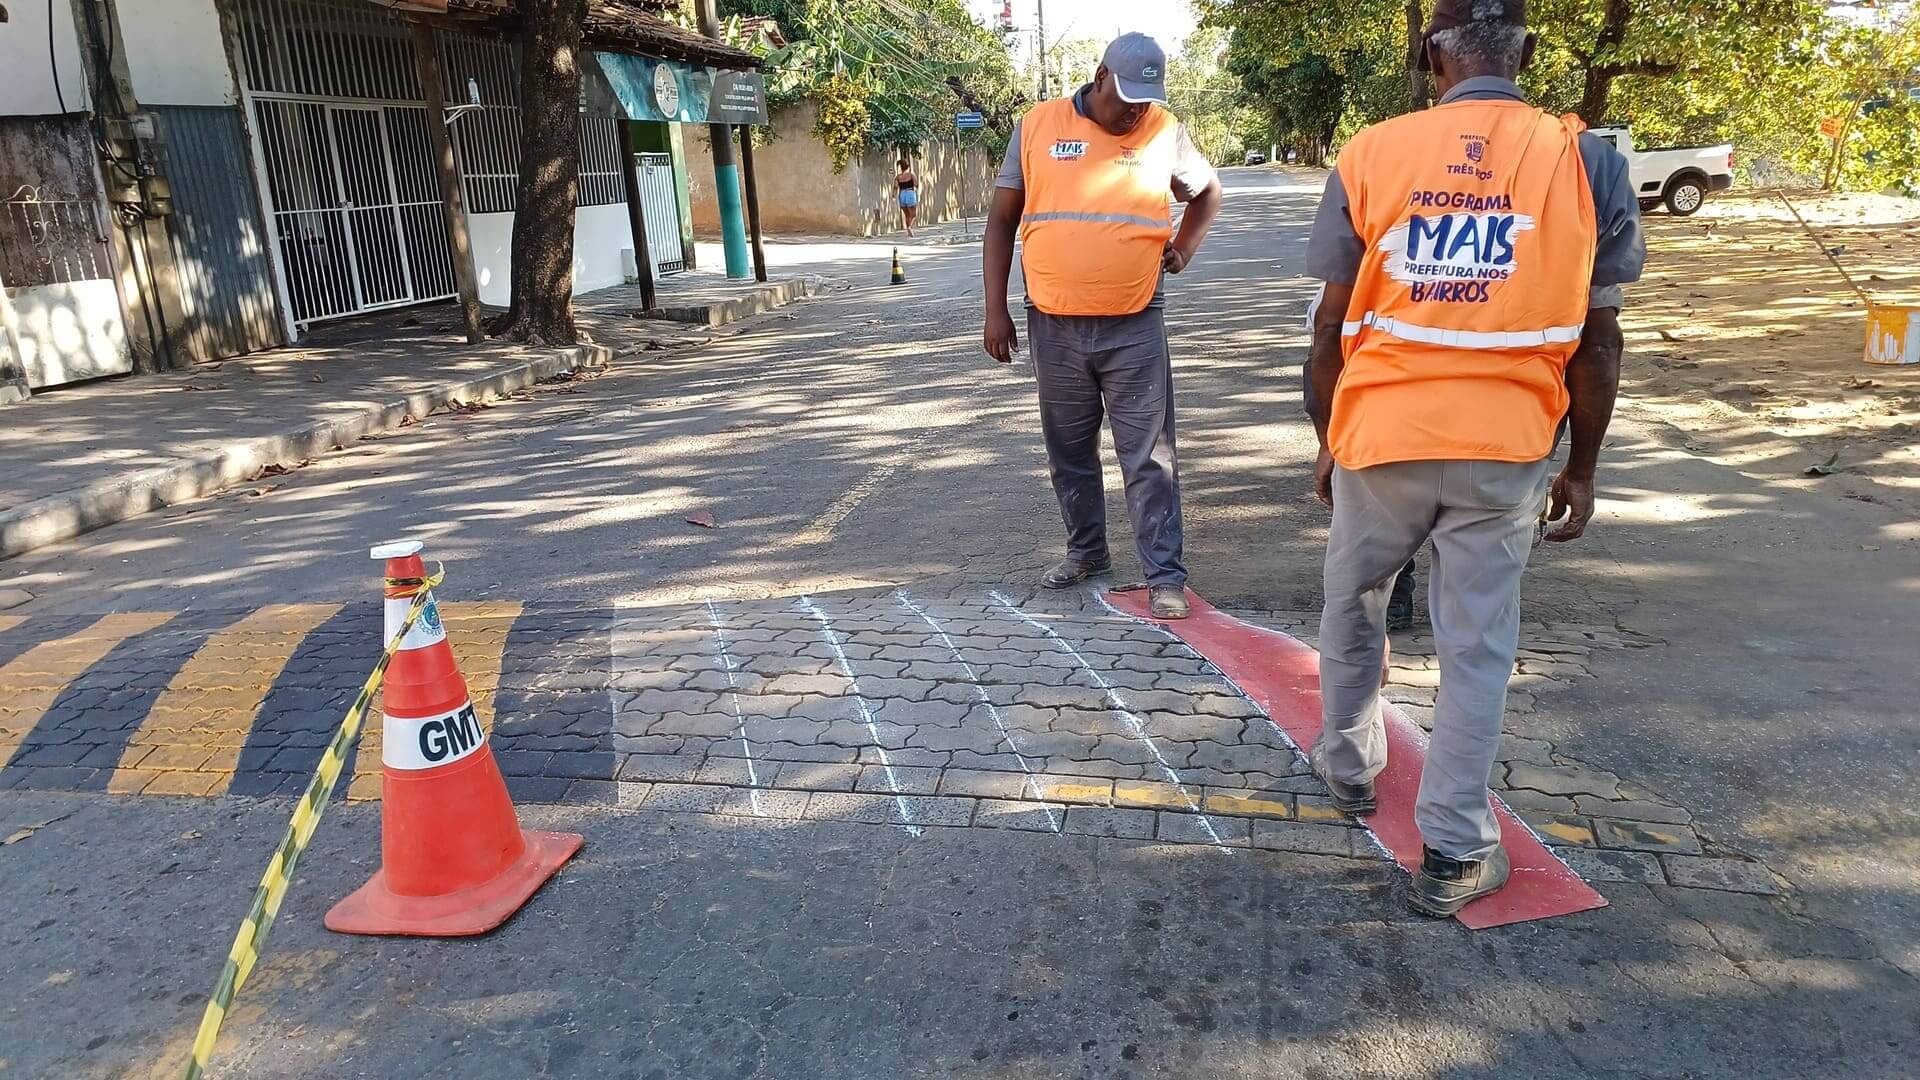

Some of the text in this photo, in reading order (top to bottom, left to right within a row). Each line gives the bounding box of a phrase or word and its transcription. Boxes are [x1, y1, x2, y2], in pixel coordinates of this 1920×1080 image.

[1055, 142, 1083, 154] MAIS
[1446, 162, 1493, 181] TRÊS ROS
[1410, 190, 1513, 212] PROGRAMA
[1406, 214, 1515, 266] MAIS
[1404, 262, 1509, 280] PREFEITURA NOS
[1410, 280, 1490, 303] BAIRROS
